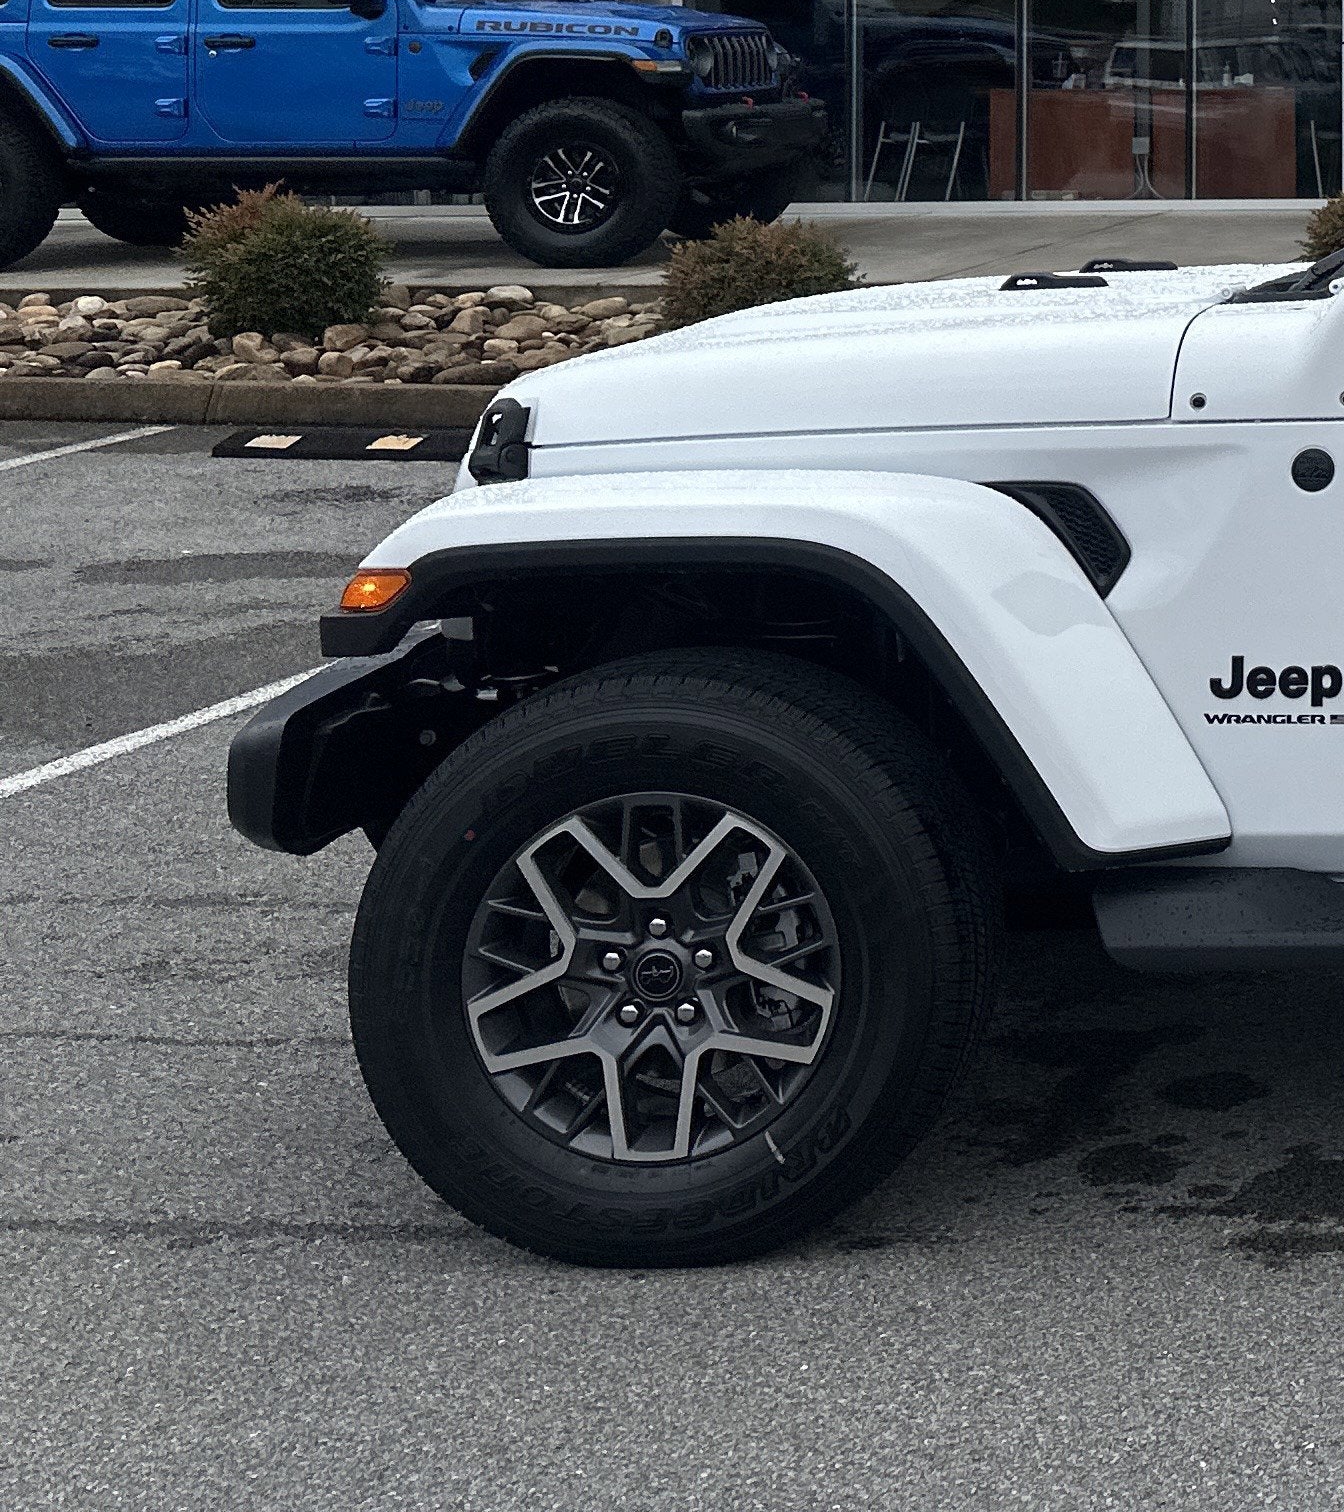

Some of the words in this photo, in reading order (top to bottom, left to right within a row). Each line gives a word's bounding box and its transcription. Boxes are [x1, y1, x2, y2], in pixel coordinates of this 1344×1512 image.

[475, 20, 639, 36] RUBICON
[1209, 655, 1342, 707] Jeep
[1203, 713, 1326, 725] WRANGLER
